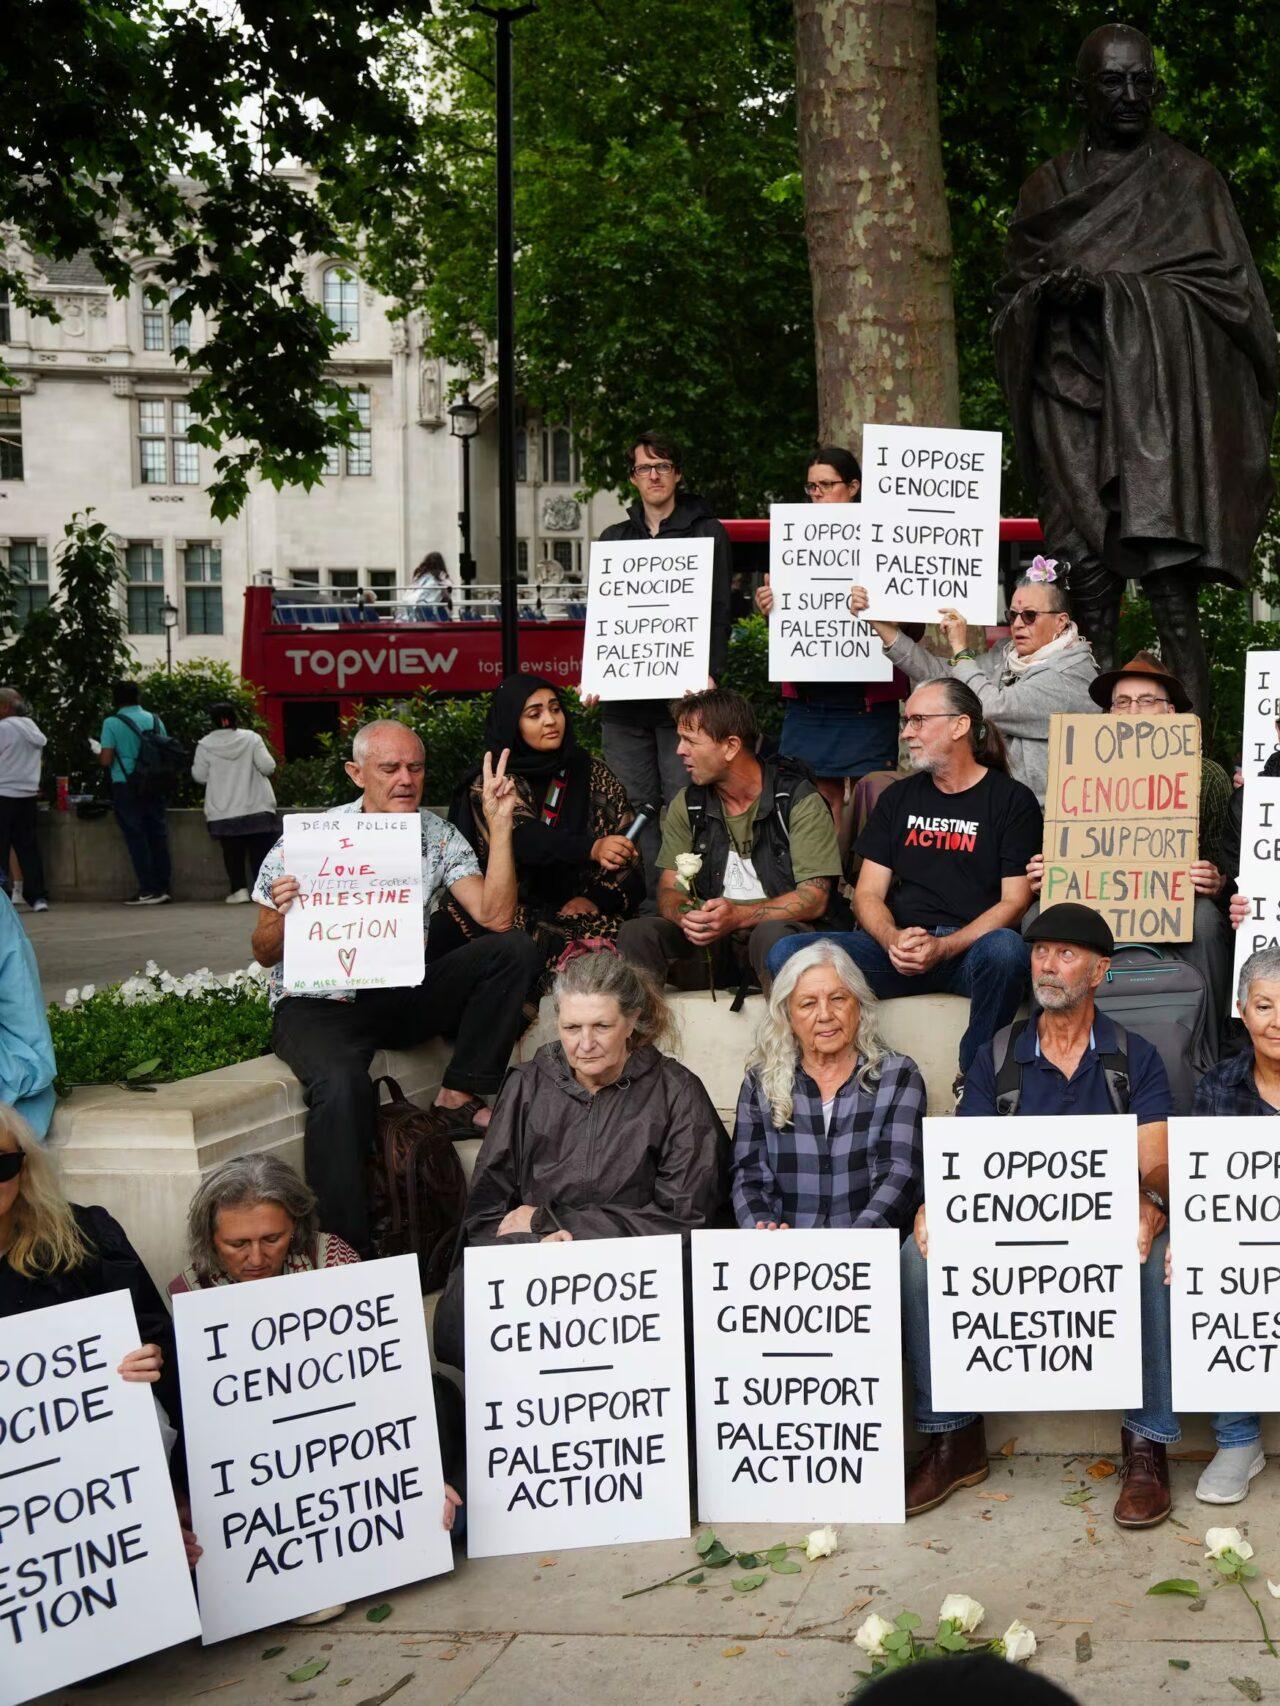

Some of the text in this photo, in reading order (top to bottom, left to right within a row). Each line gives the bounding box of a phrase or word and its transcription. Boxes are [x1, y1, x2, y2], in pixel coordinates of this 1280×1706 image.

[876, 446, 985, 472] I OPPOSE
[878, 476, 980, 500] GENOCIDE
[782, 523, 795, 542] I
[871, 523, 984, 547] I SUPPORT
[601, 554, 699, 575] I OPPOSE
[876, 553, 983, 577] PALESTINE
[599, 577, 695, 597] GENOCIDE
[781, 592, 853, 611] I SUPP
[884, 577, 968, 599] ACTION
[596, 616, 699, 637] I SUPPORT
[597, 641, 695, 661] PALESTINE
[790, 639, 870, 658] ACTION
[602, 660, 679, 678] ACTION
[1257, 671, 1271, 690] I
[1066, 720, 1197, 765] I OPPOSE
[1253, 742, 1266, 762] I
[1062, 772, 1188, 816] GENOCIDE
[302, 820, 340, 831] DEAR
[907, 815, 979, 836] PALESTINE
[1259, 802, 1275, 828] I
[339, 838, 353, 849] I
[905, 829, 977, 852] ACTION
[1059, 826, 1193, 858] I SUPPORT
[318, 857, 375, 877] LOVE
[1048, 866, 1186, 900] PALESTINE
[1251, 896, 1267, 921] I
[942, 1149, 1108, 1181] I OPPOSE
[1189, 1151, 1209, 1180] I
[946, 1191, 1113, 1224] GENOCIDE
[487, 1269, 658, 1310] I OPPOSE
[712, 1261, 871, 1292] I OPPOSE
[941, 1263, 1124, 1297] I SUPPORT
[1186, 1266, 1204, 1296] I
[203, 1293, 399, 1362] I OPPOSE
[490, 1313, 661, 1353] GENOCIDE
[716, 1304, 872, 1334] GENOCIDE
[952, 1309, 1117, 1341] PALESTINE
[212, 1339, 402, 1406] GENOCIDE
[965, 1343, 1093, 1373] ACTION
[713, 1376, 880, 1407] I SUPPORT
[483, 1387, 671, 1431] I SUPPORT
[717, 1421, 882, 1452] PALESTINE
[210, 1416, 417, 1498] I SUPPORT
[488, 1433, 666, 1479] PALESTINE
[731, 1455, 863, 1485] ACTION
[506, 1471, 643, 1512] ACTION
[223, 1467, 423, 1549] PALESTINE
[246, 1510, 404, 1584] ACTION
